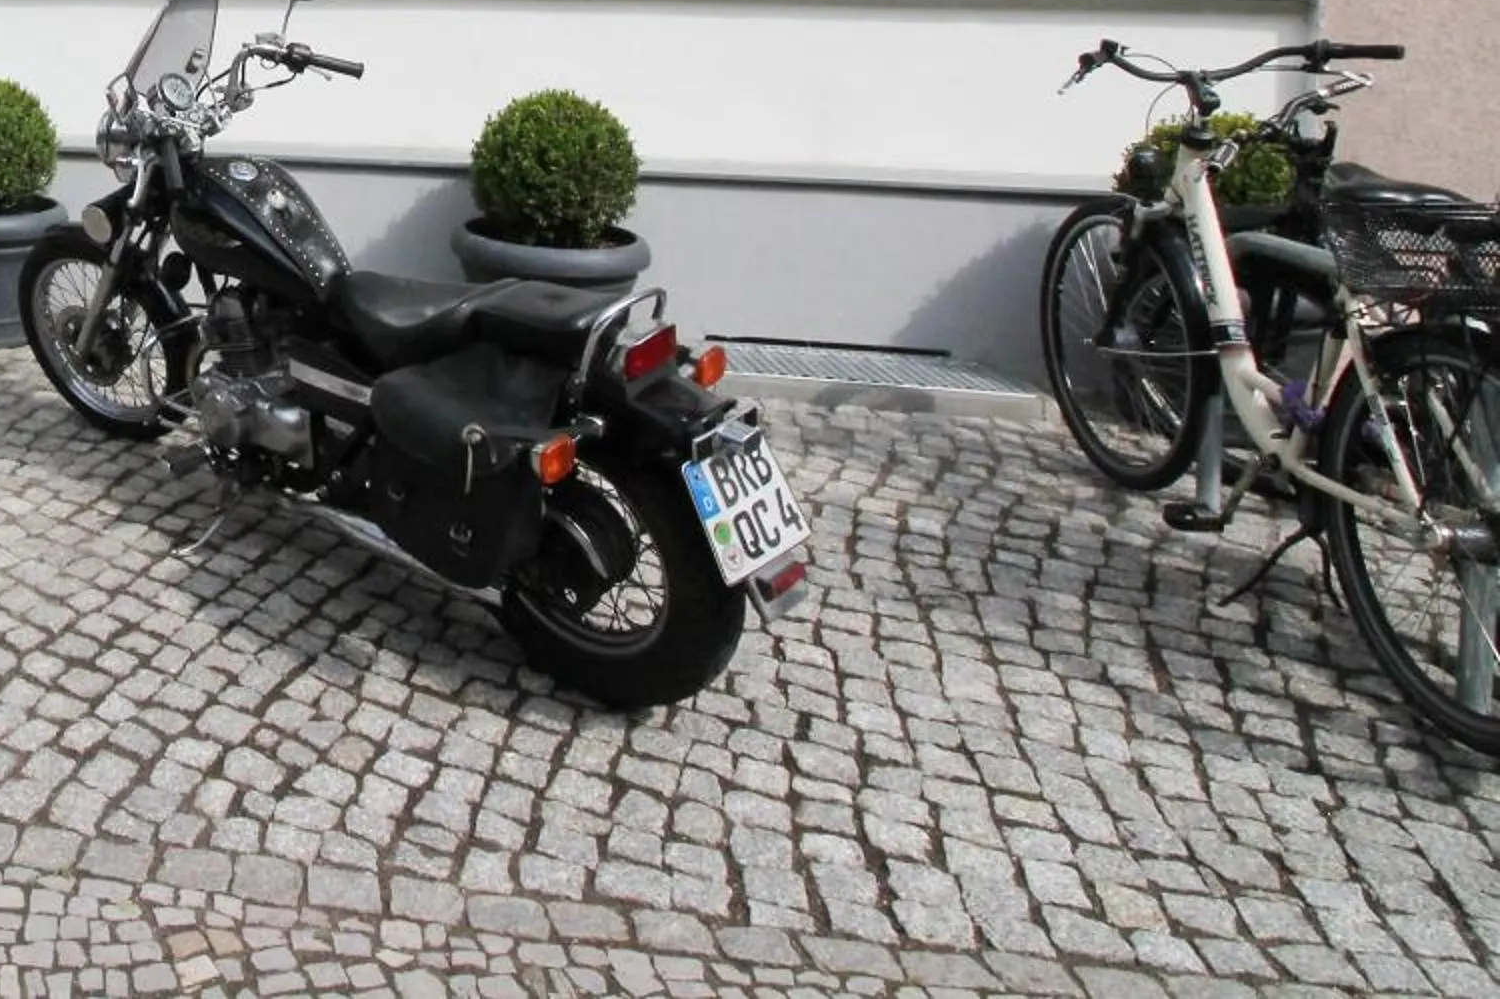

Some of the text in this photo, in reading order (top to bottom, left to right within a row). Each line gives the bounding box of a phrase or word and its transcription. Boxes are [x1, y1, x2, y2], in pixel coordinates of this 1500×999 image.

[708, 447, 772, 508] BRB
[732, 487, 802, 560] QC 4
